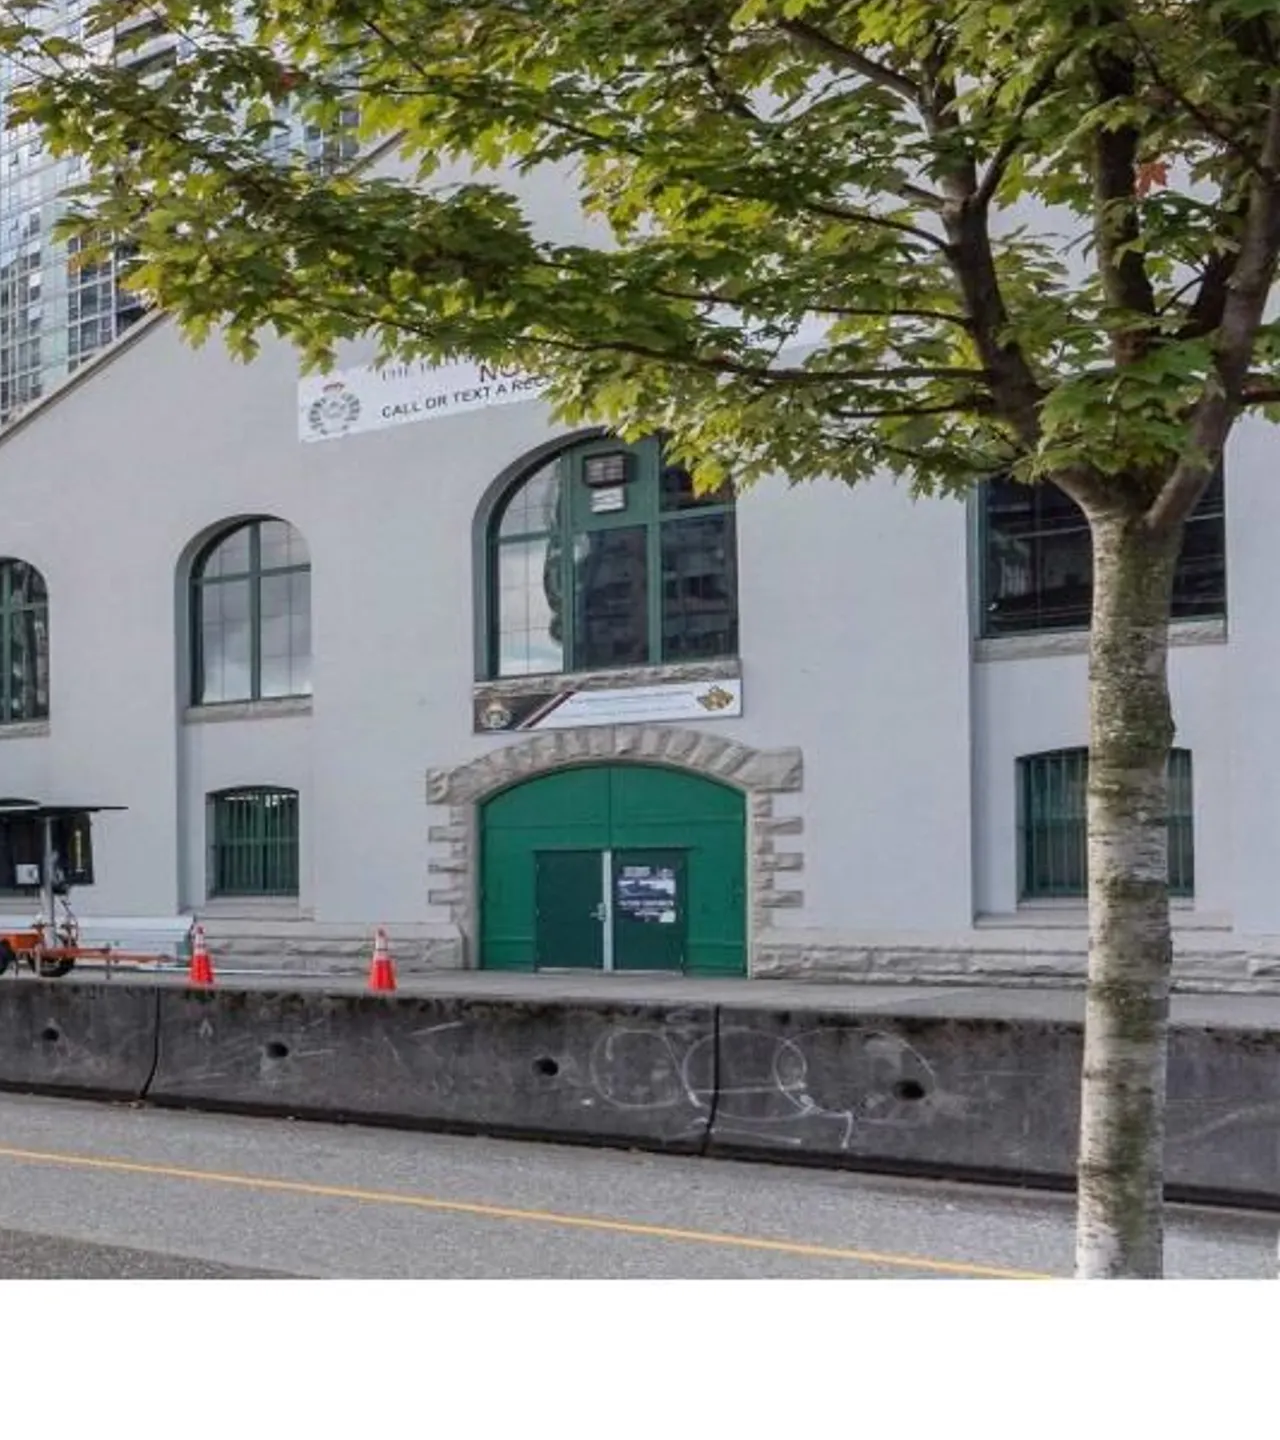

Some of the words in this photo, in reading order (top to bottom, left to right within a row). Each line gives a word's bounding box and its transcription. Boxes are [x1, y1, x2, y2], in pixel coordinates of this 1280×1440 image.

[382, 404, 422, 419] CALL
[425, 394, 449, 409] OR
[453, 386, 490, 404] TEXT
[496, 383, 508, 395] A
[512, 376, 545, 392] REC
